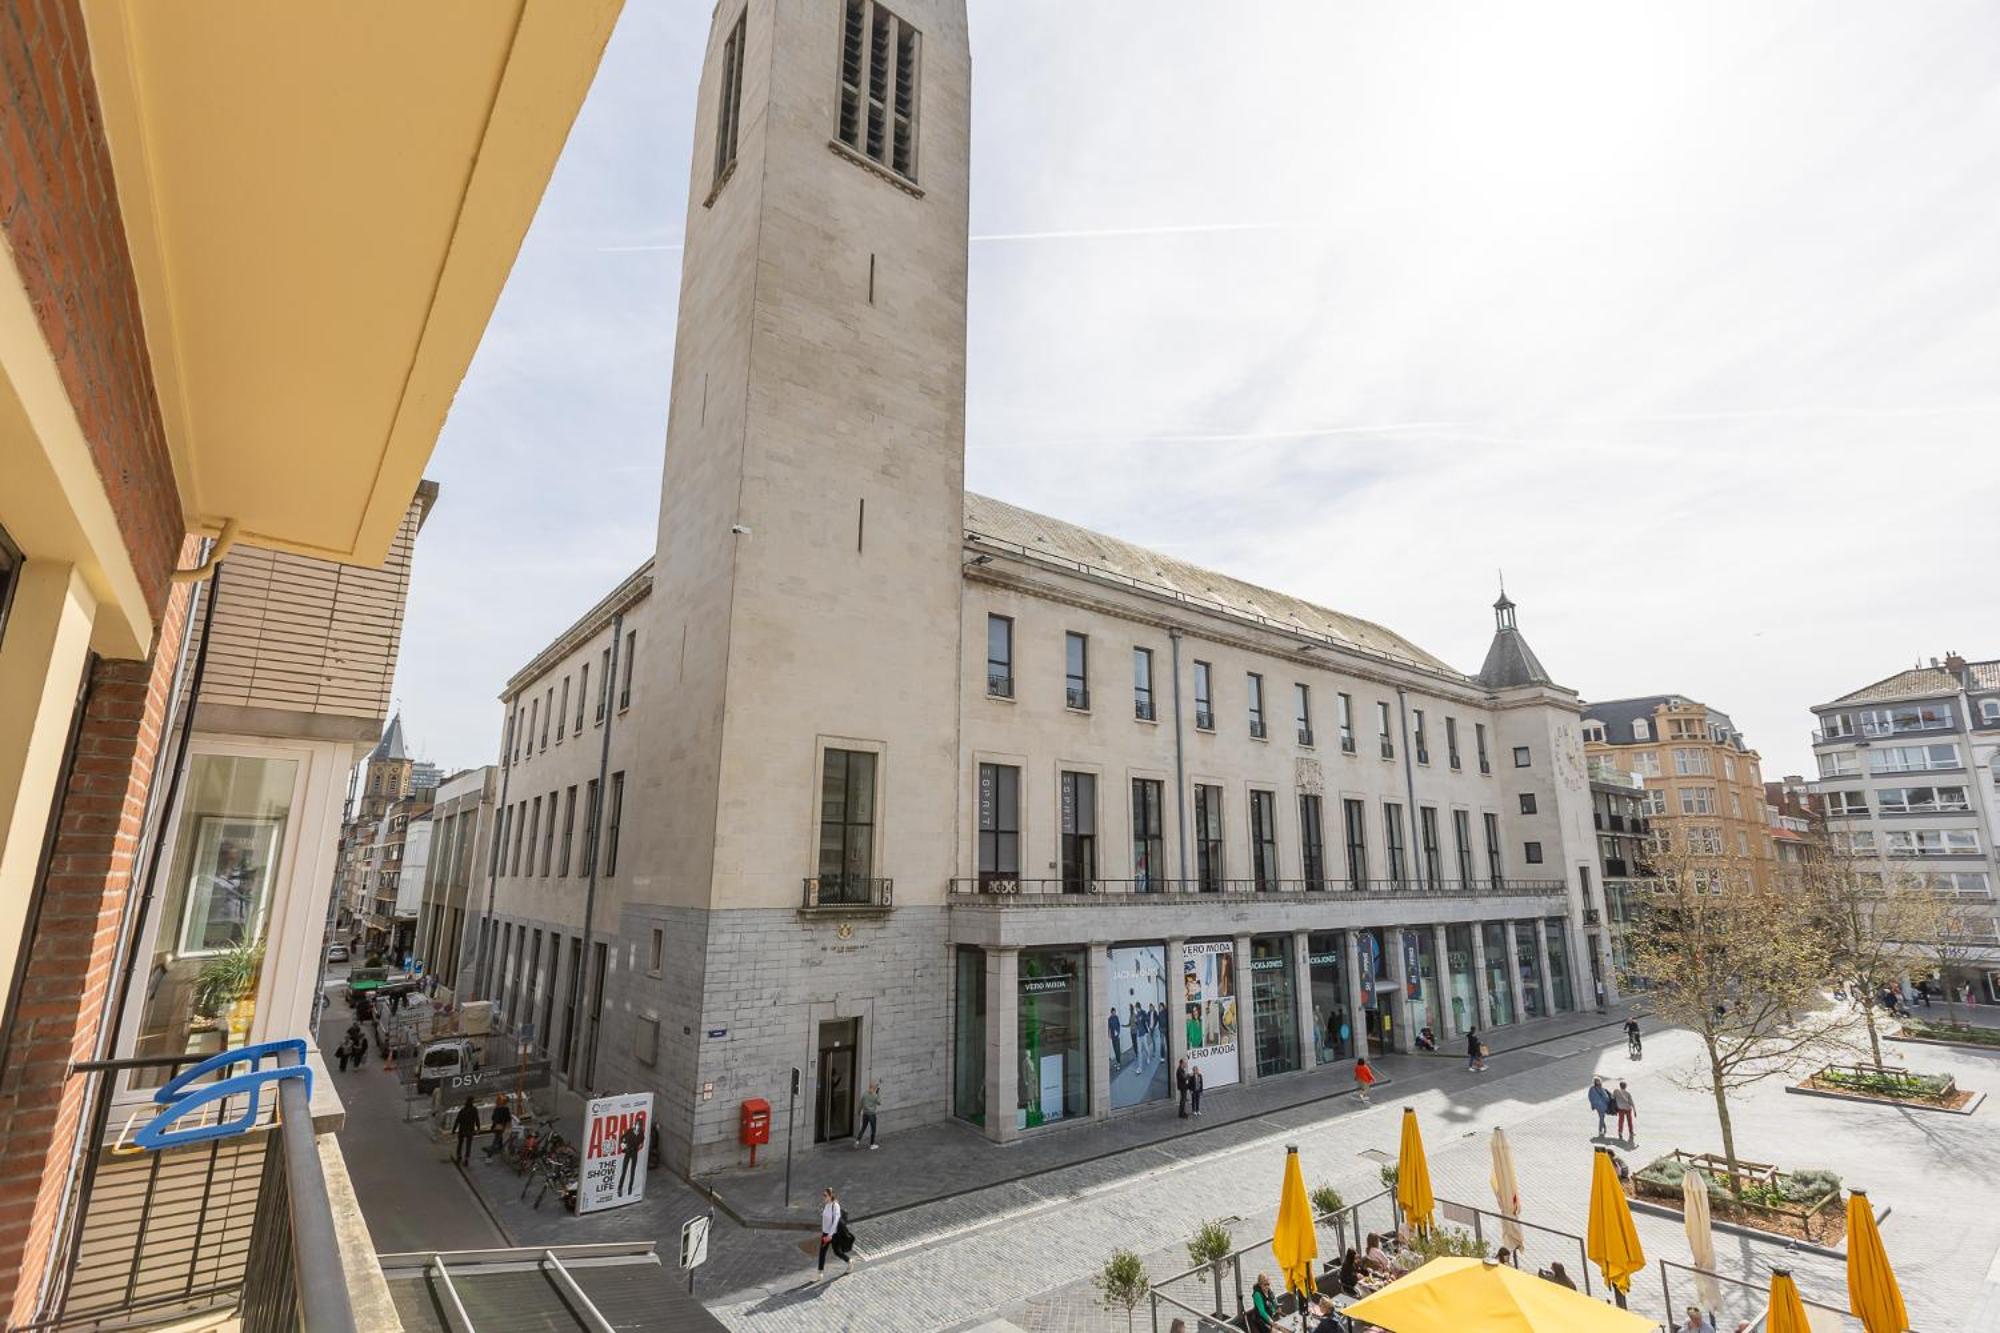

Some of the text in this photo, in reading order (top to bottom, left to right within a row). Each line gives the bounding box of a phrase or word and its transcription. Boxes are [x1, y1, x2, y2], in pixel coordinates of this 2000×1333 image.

[982, 768, 991, 825] ESPRIT
[1063, 776, 1072, 829] ESPRIT
[1183, 943, 1230, 954] VERO MODA
[1024, 980, 1067, 991] VERO MODA
[1186, 1043, 1236, 1060] VERO MODA
[452, 1073, 483, 1088] DSV
[587, 1109, 647, 1160] ARNO
[599, 1159, 617, 1169] THE
[587, 1168, 615, 1179] SHOW
[603, 1175, 615, 1183] OF
[596, 1183, 615, 1193] LIFE
